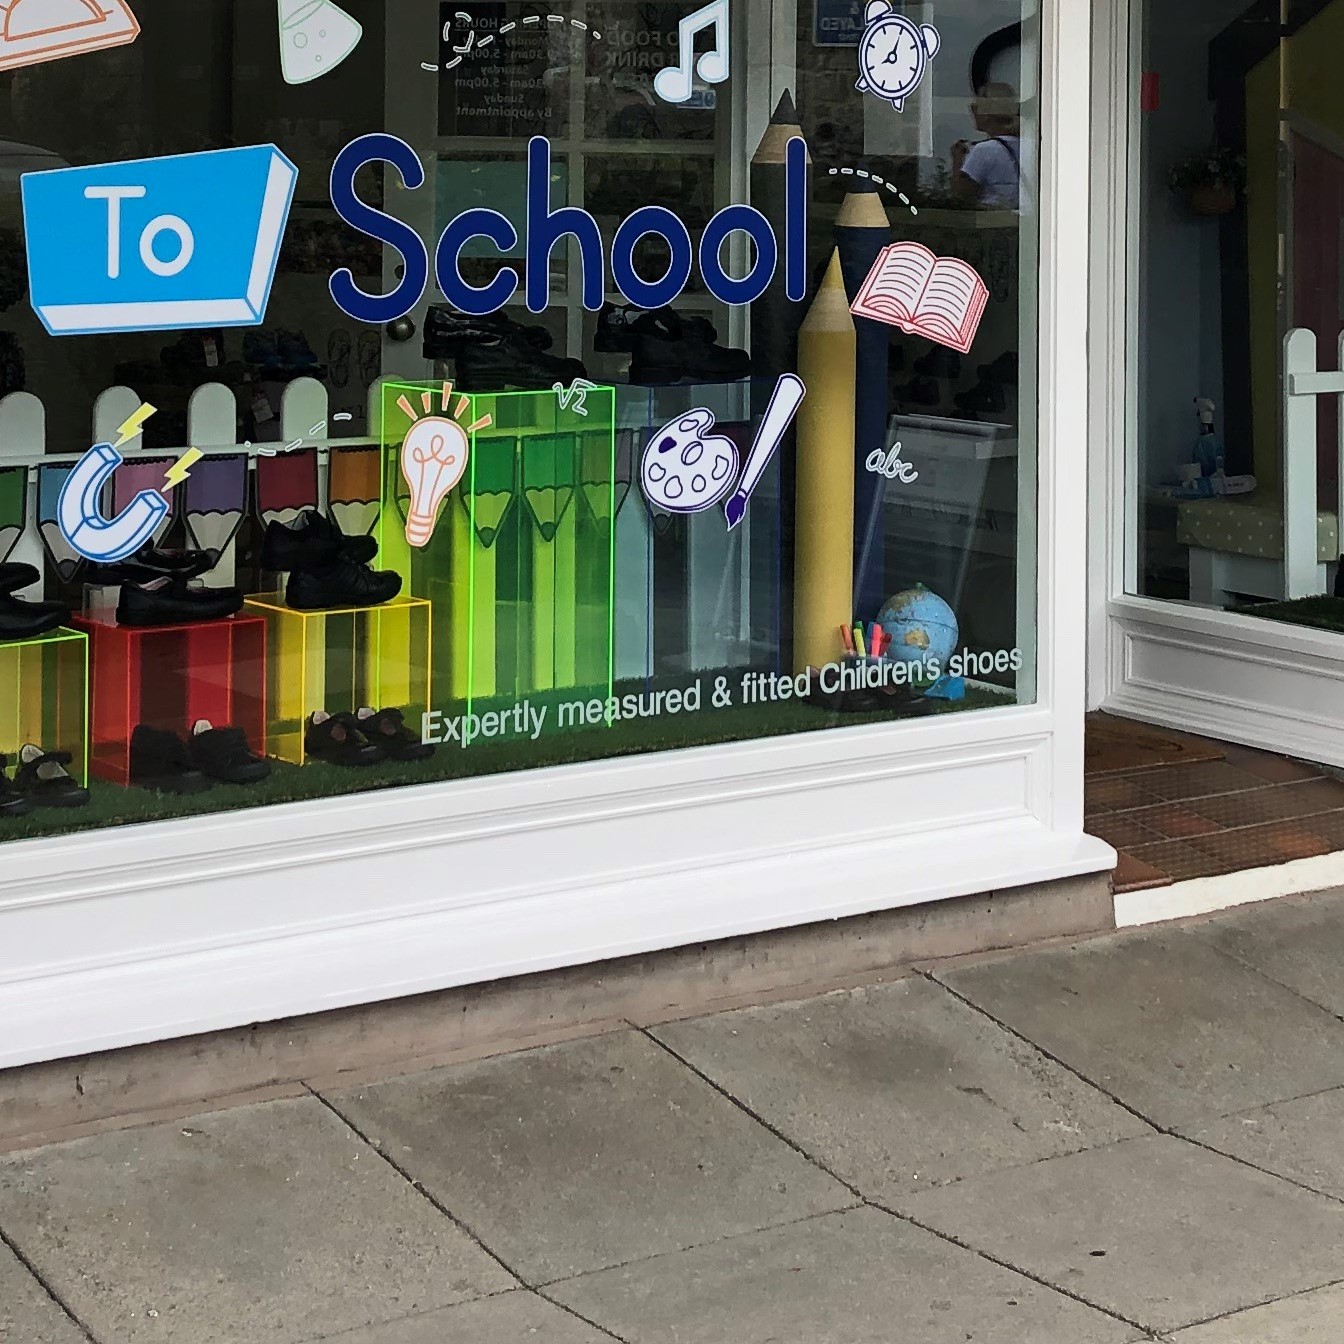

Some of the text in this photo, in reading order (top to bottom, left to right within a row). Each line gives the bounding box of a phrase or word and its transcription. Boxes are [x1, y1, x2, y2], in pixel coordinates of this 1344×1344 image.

[83, 184, 195, 280] To
[329, 133, 807, 324] School
[421, 646, 1024, 747] Expertly measured & fitted Children's shoes
